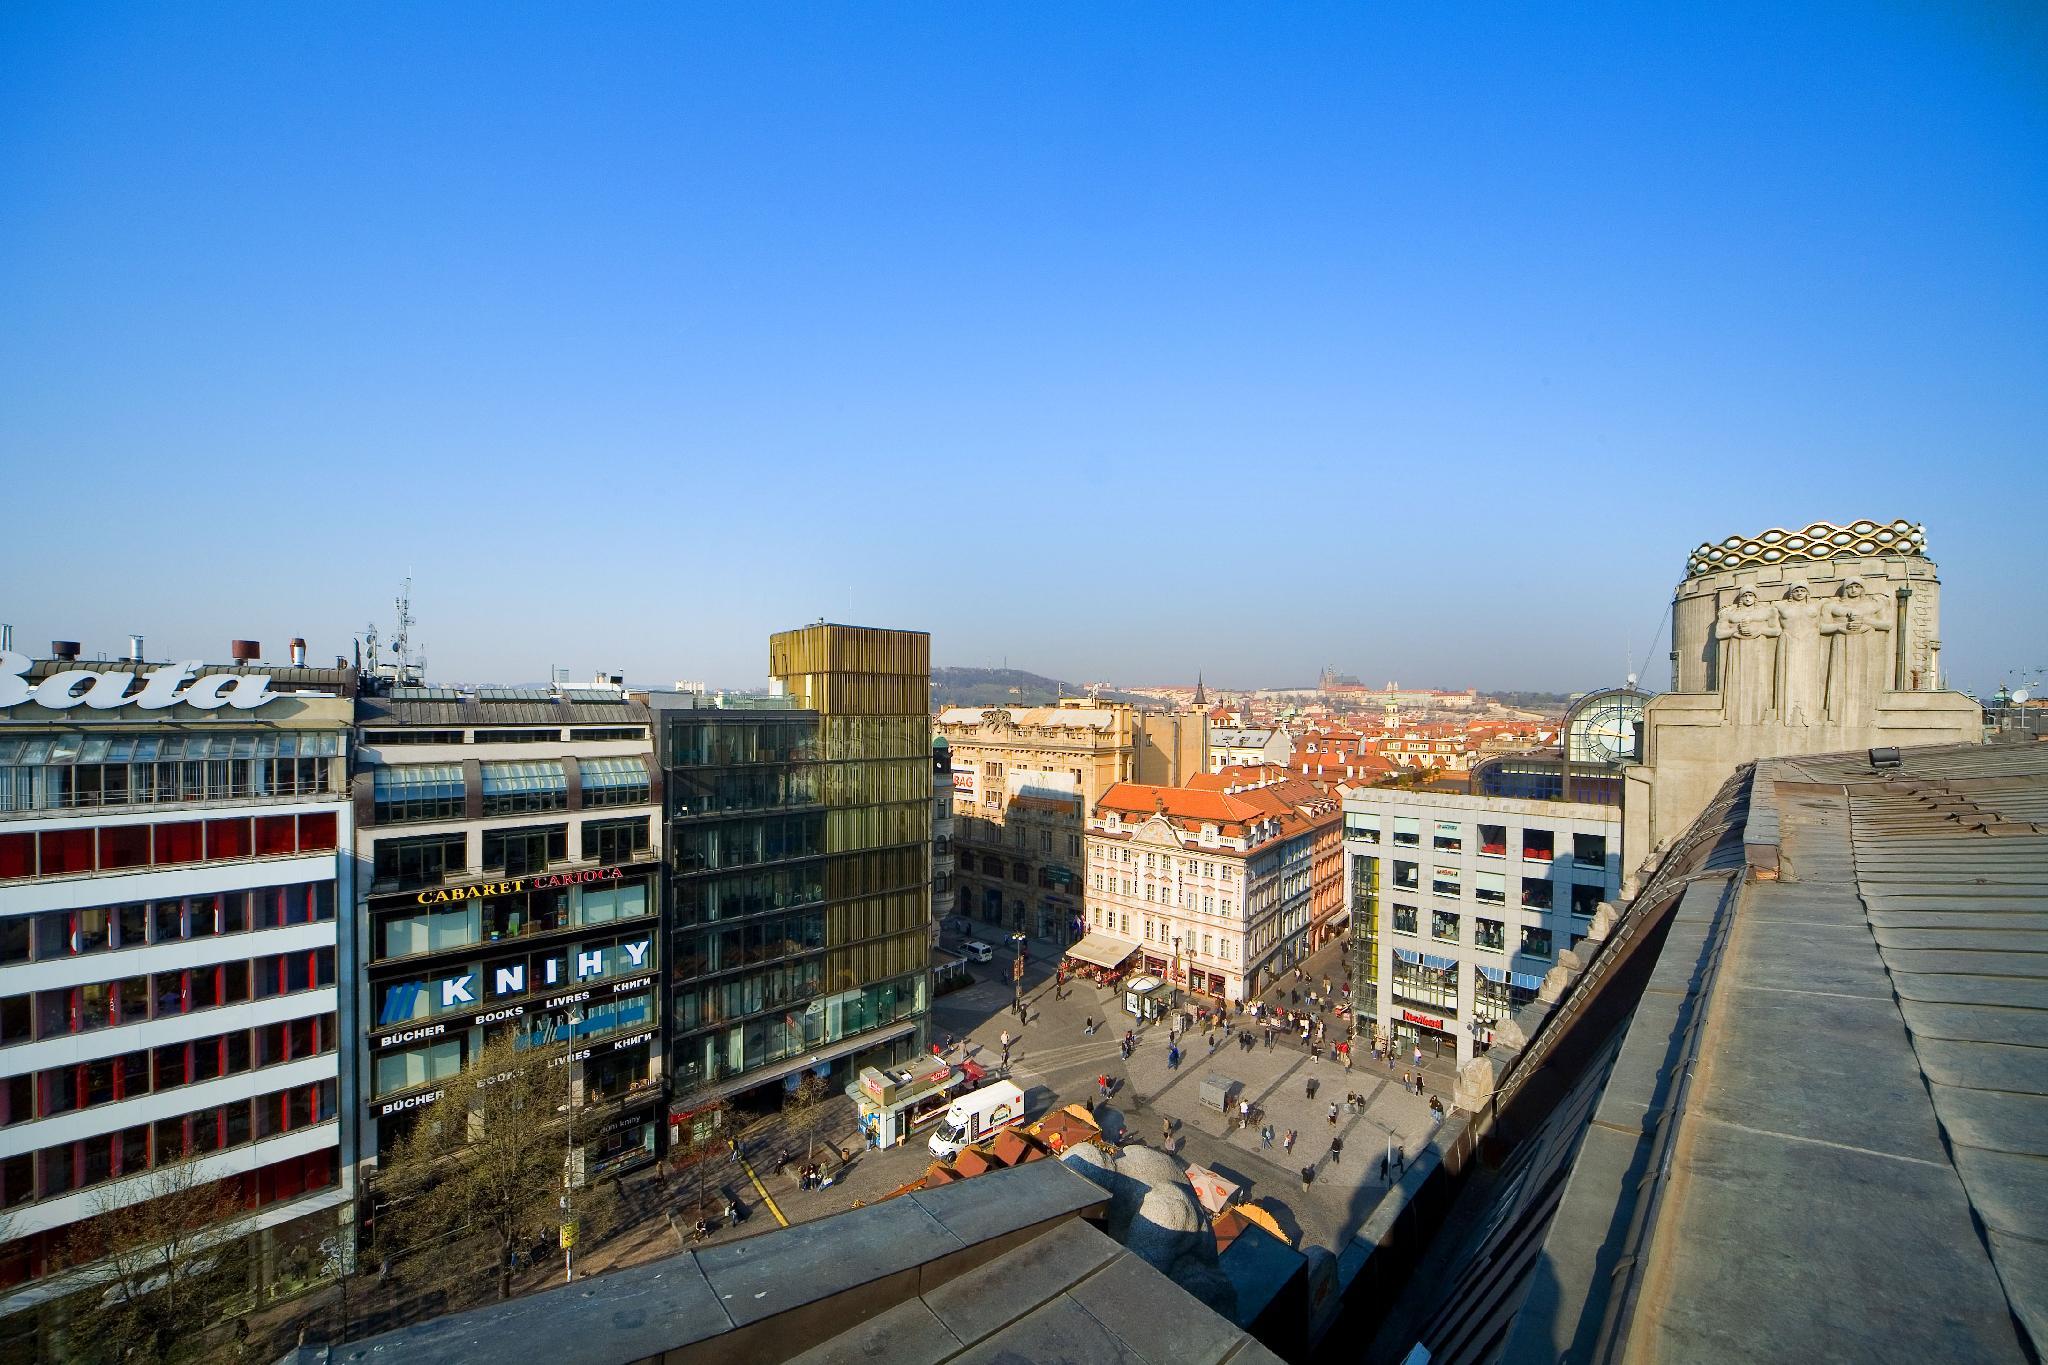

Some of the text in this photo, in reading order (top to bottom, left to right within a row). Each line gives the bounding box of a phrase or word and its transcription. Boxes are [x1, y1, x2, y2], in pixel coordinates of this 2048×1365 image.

[417, 867, 624, 904] CABARET CARIOCA
[442, 940, 650, 1007] KNIHY
[613, 976, 651, 993] КНИГИ
[546, 991, 590, 1009] LIVRES
[475, 1006, 524, 1025] BOOKS
[381, 1025, 445, 1047] BÜCHER
[614, 1032, 652, 1050] КНИГИ
[547, 1050, 591, 1068] LIVRES
[382, 1089, 445, 1115] BÜCHER
